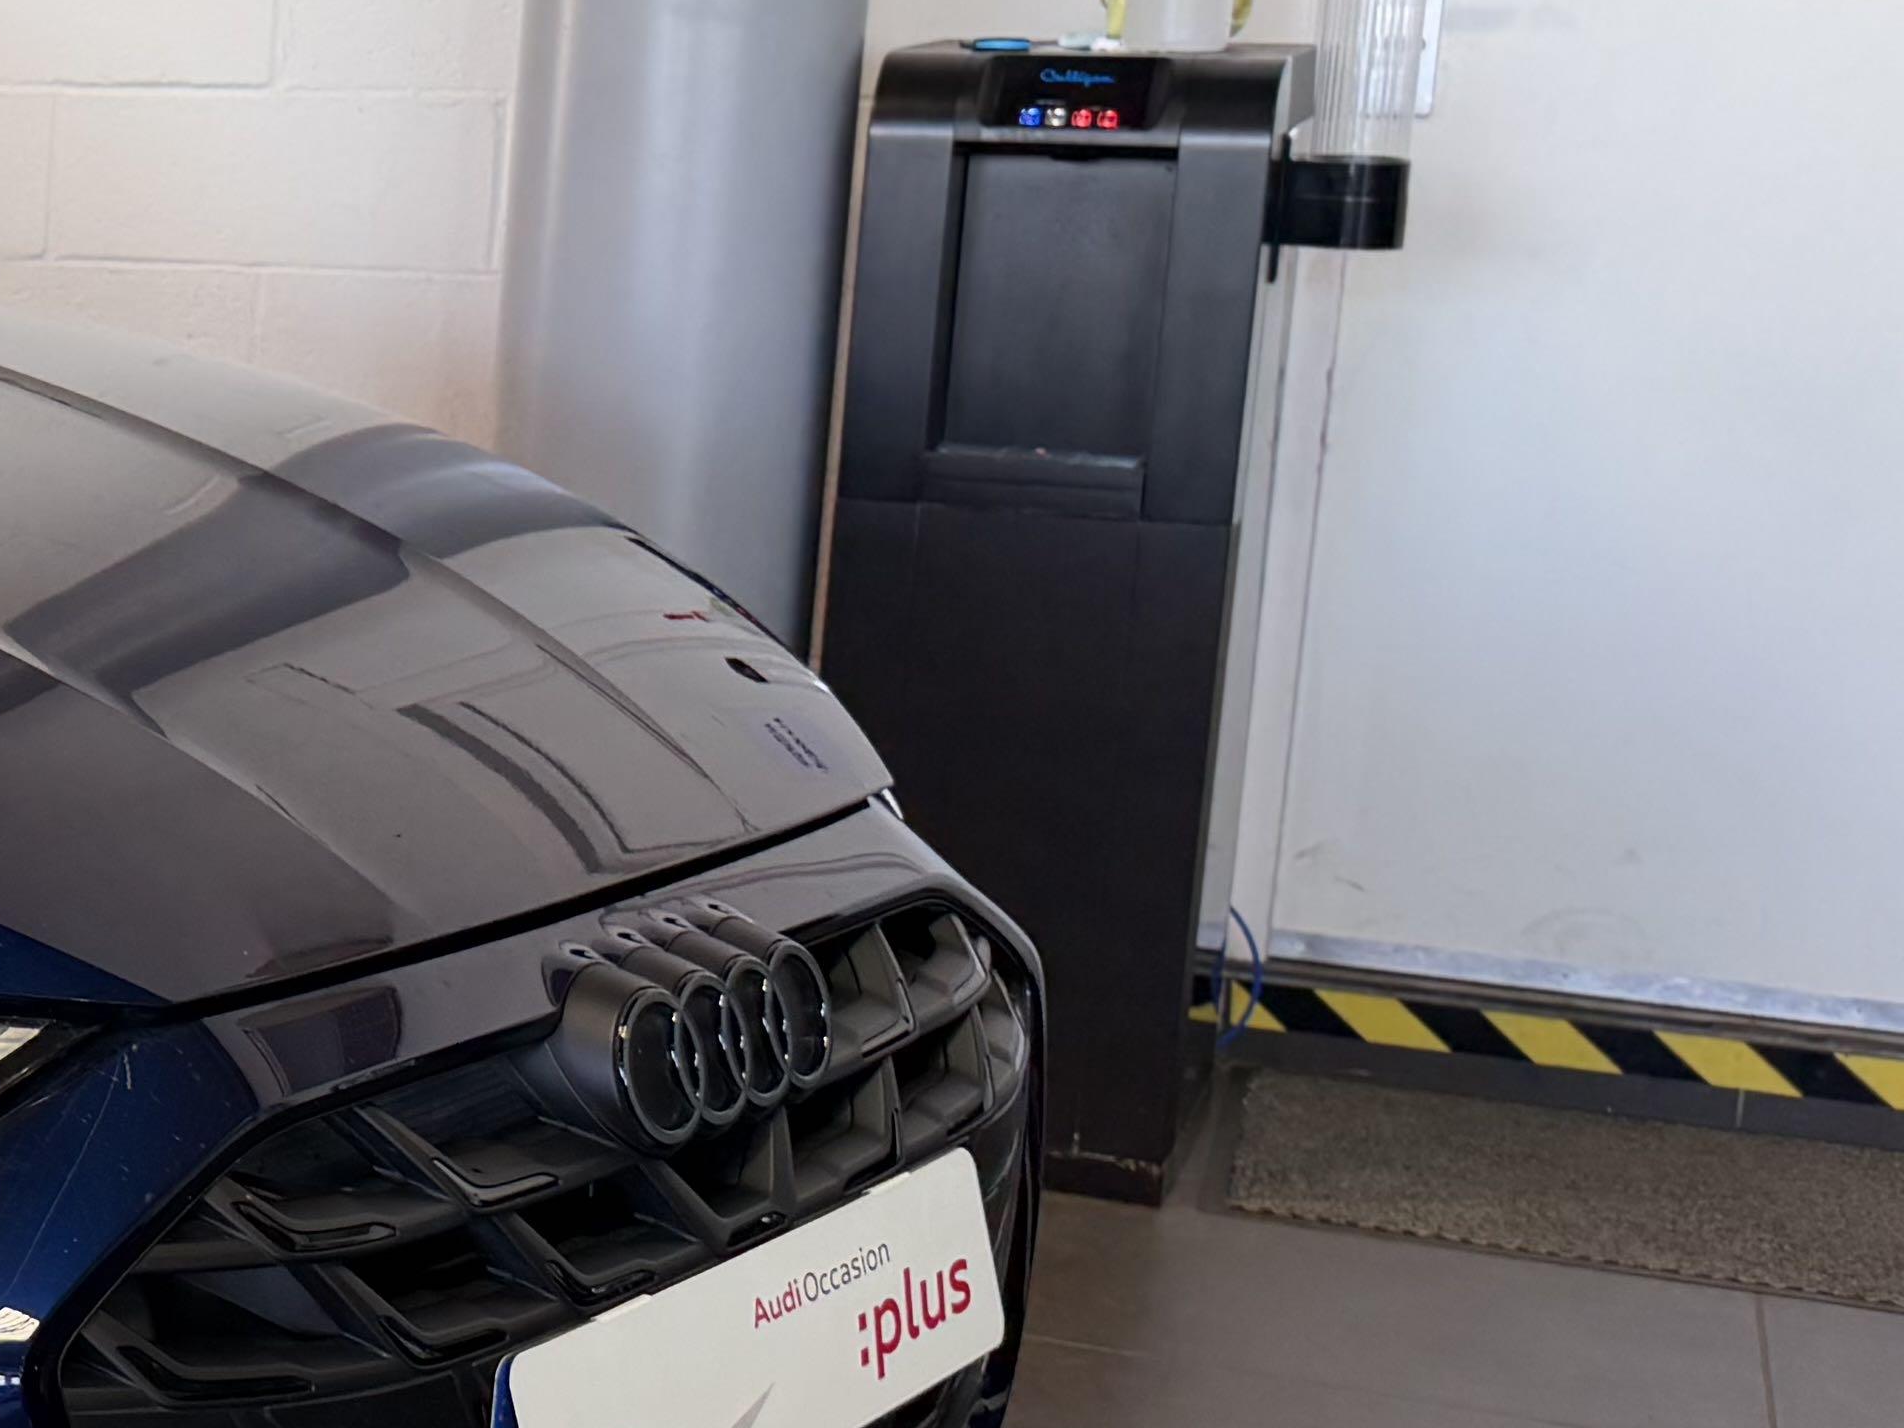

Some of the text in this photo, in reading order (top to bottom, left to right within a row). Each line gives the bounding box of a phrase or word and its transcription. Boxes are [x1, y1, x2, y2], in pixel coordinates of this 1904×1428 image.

[754, 1243, 890, 1329] Audi Occasion
[858, 1258, 971, 1380] :plus
